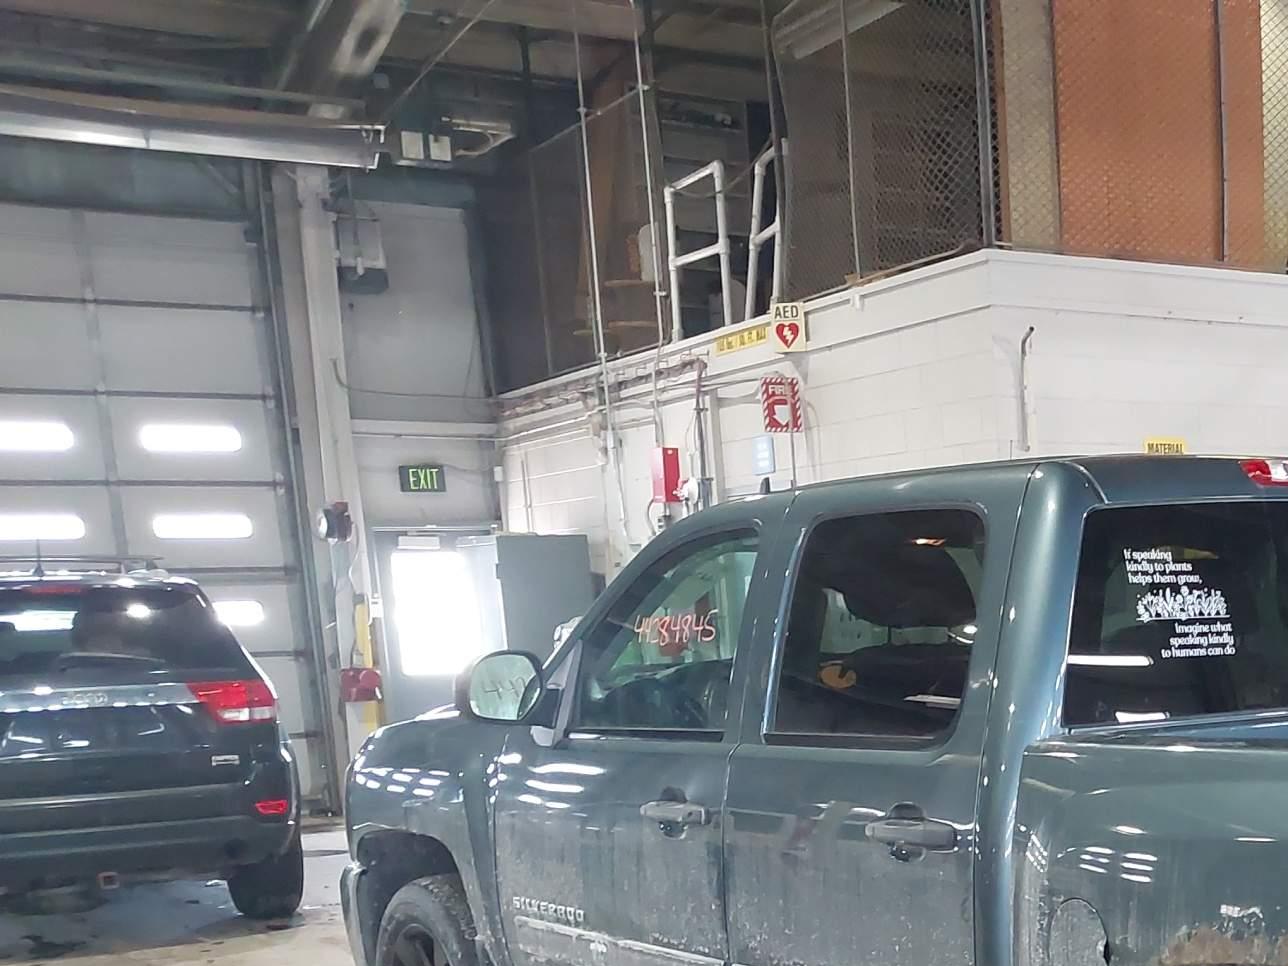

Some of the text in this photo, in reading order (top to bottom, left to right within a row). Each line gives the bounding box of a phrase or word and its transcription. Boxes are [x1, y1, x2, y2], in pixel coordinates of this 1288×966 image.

[774, 305, 799, 319] AED
[1147, 442, 1184, 455] MATERIAL
[409, 468, 439, 490] EXIT
[1123, 548, 1172, 562] If speaking
[1125, 560, 1193, 574] kindly to plants
[1128, 572, 1203, 586] helps them grow,
[633, 608, 719, 647] 44284845
[1174, 621, 1232, 636] Imagine what
[1169, 632, 1235, 648] speaking kindly
[1161, 645, 1236, 658] to humans can do
[512, 896, 585, 922] SILVERADO
